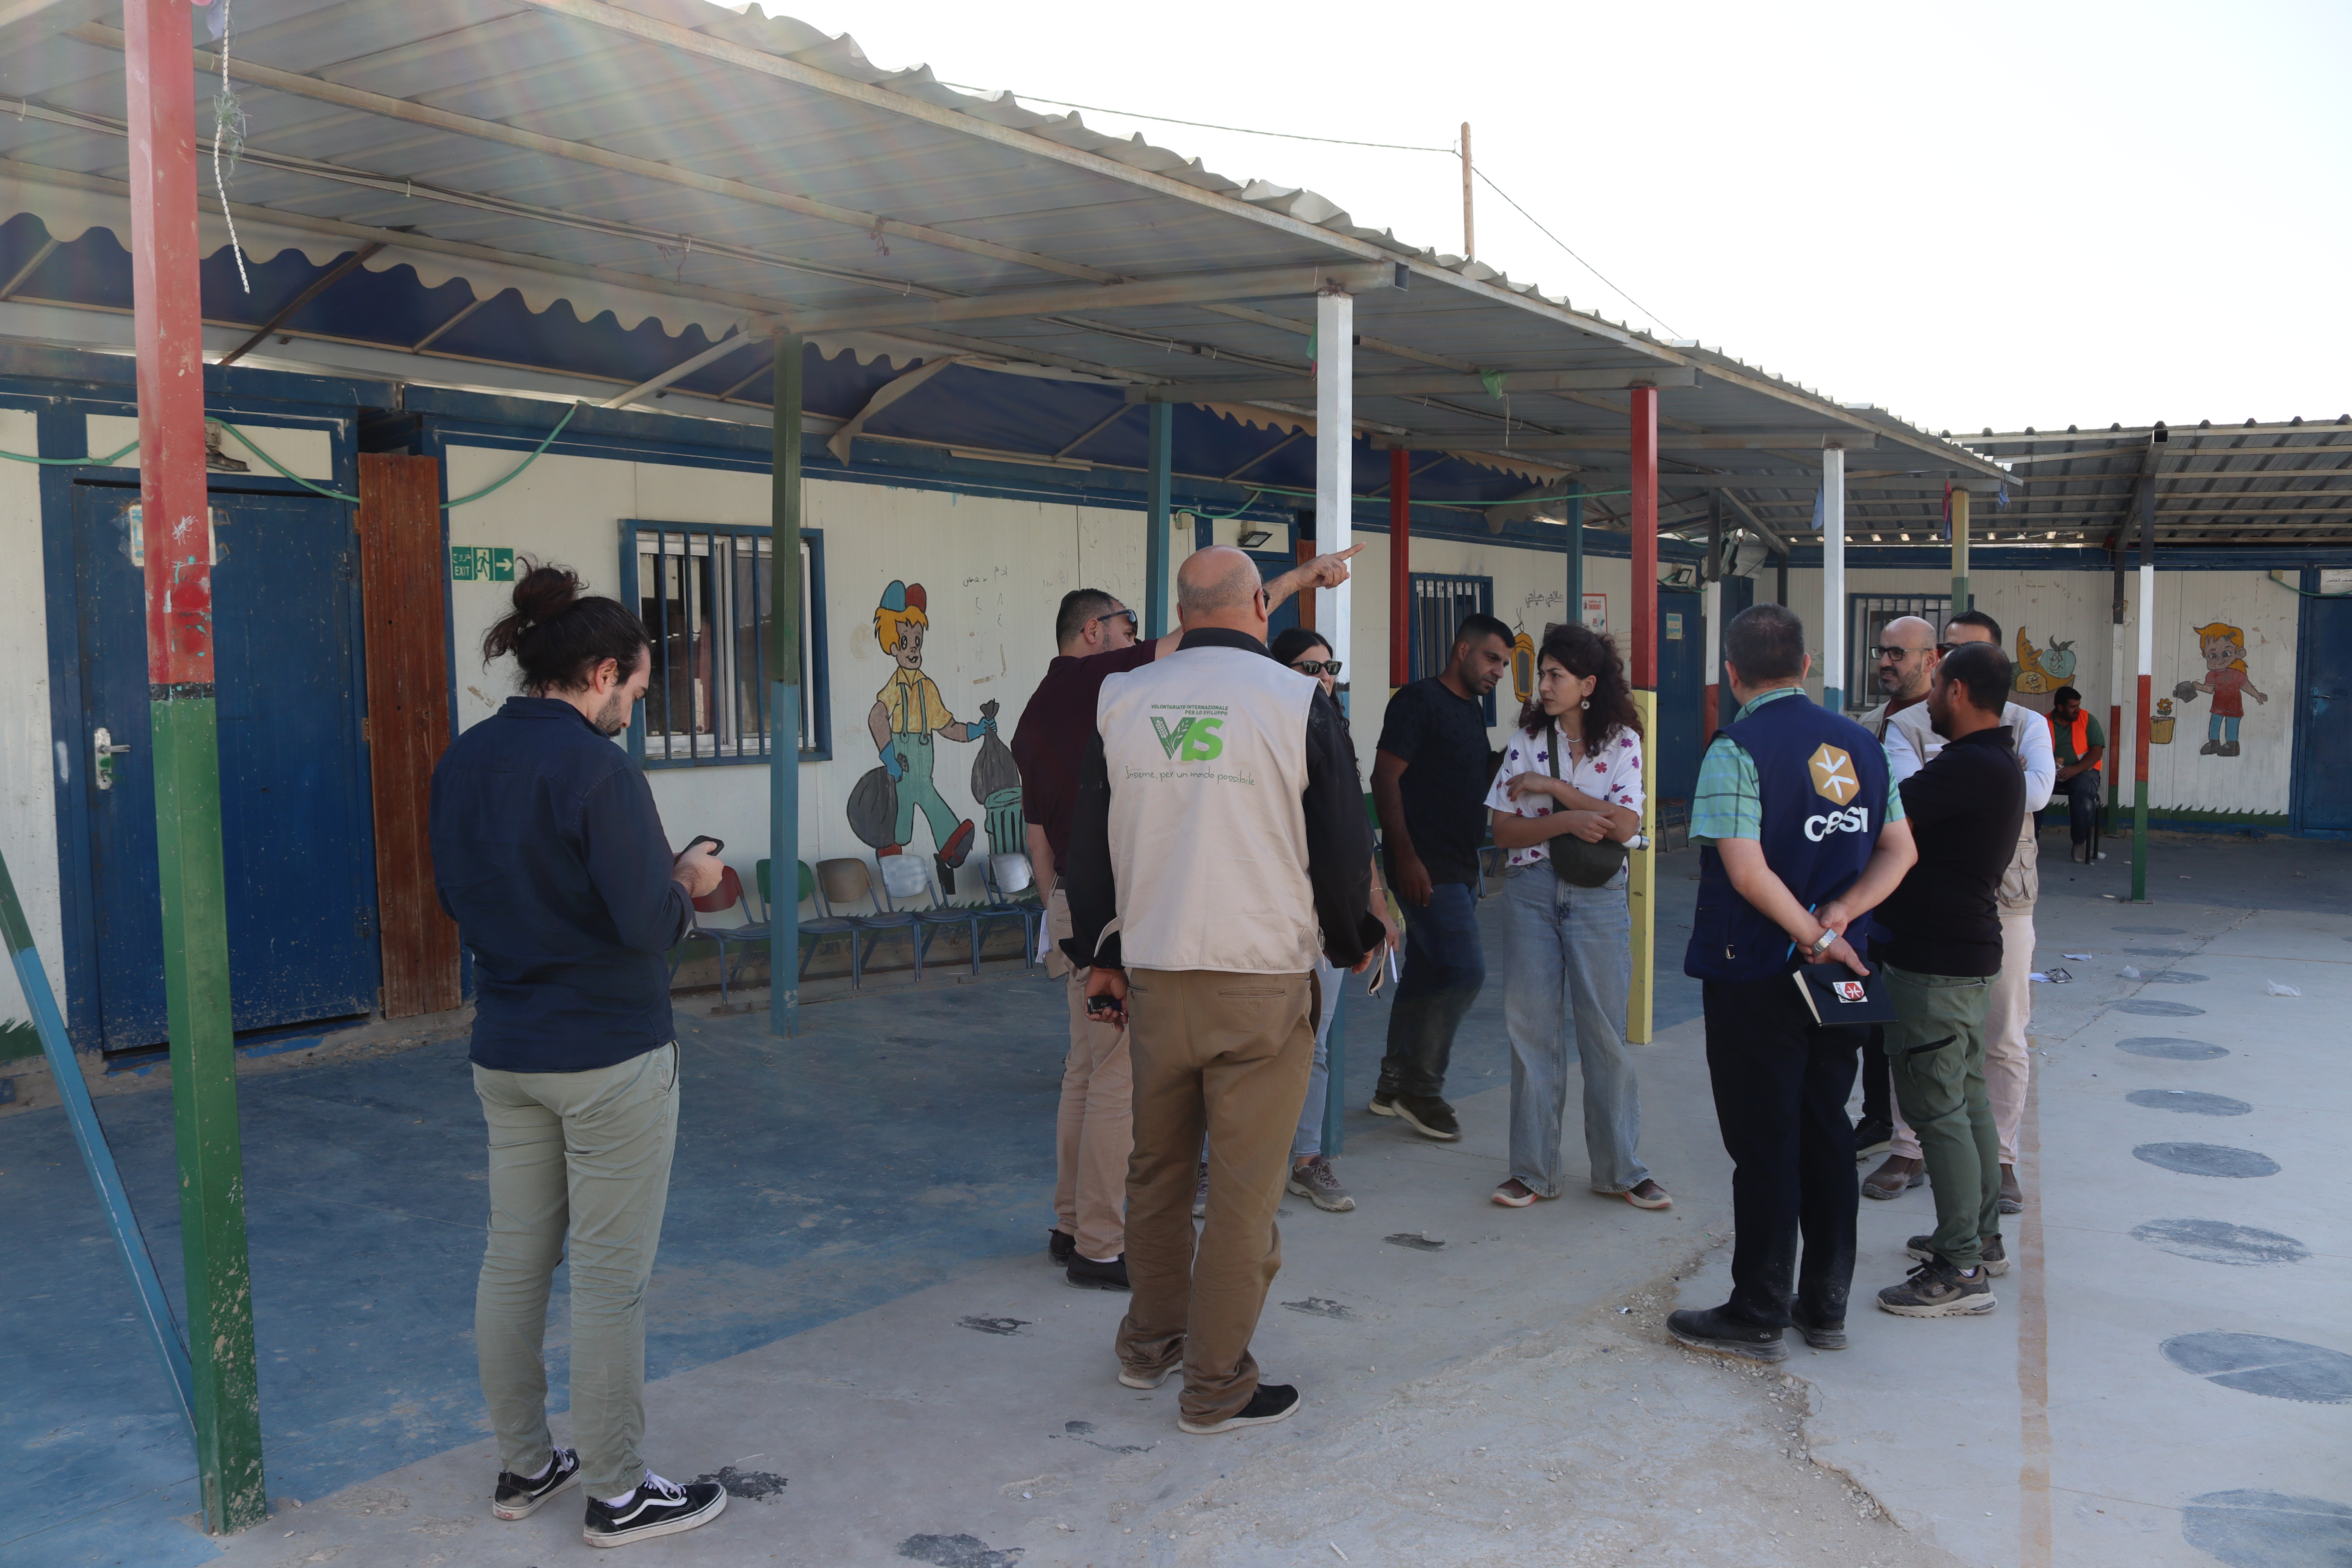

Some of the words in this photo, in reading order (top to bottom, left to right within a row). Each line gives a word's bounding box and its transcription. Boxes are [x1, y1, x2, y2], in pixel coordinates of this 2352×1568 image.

[452, 551, 471, 563] خروج
[454, 566, 470, 576] EXIT
[1125, 766, 1157, 779] Insieme,
[1160, 772, 1174, 782] per
[1191, 766, 1214, 778] mondo
[1217, 770, 1255, 785] possibile
